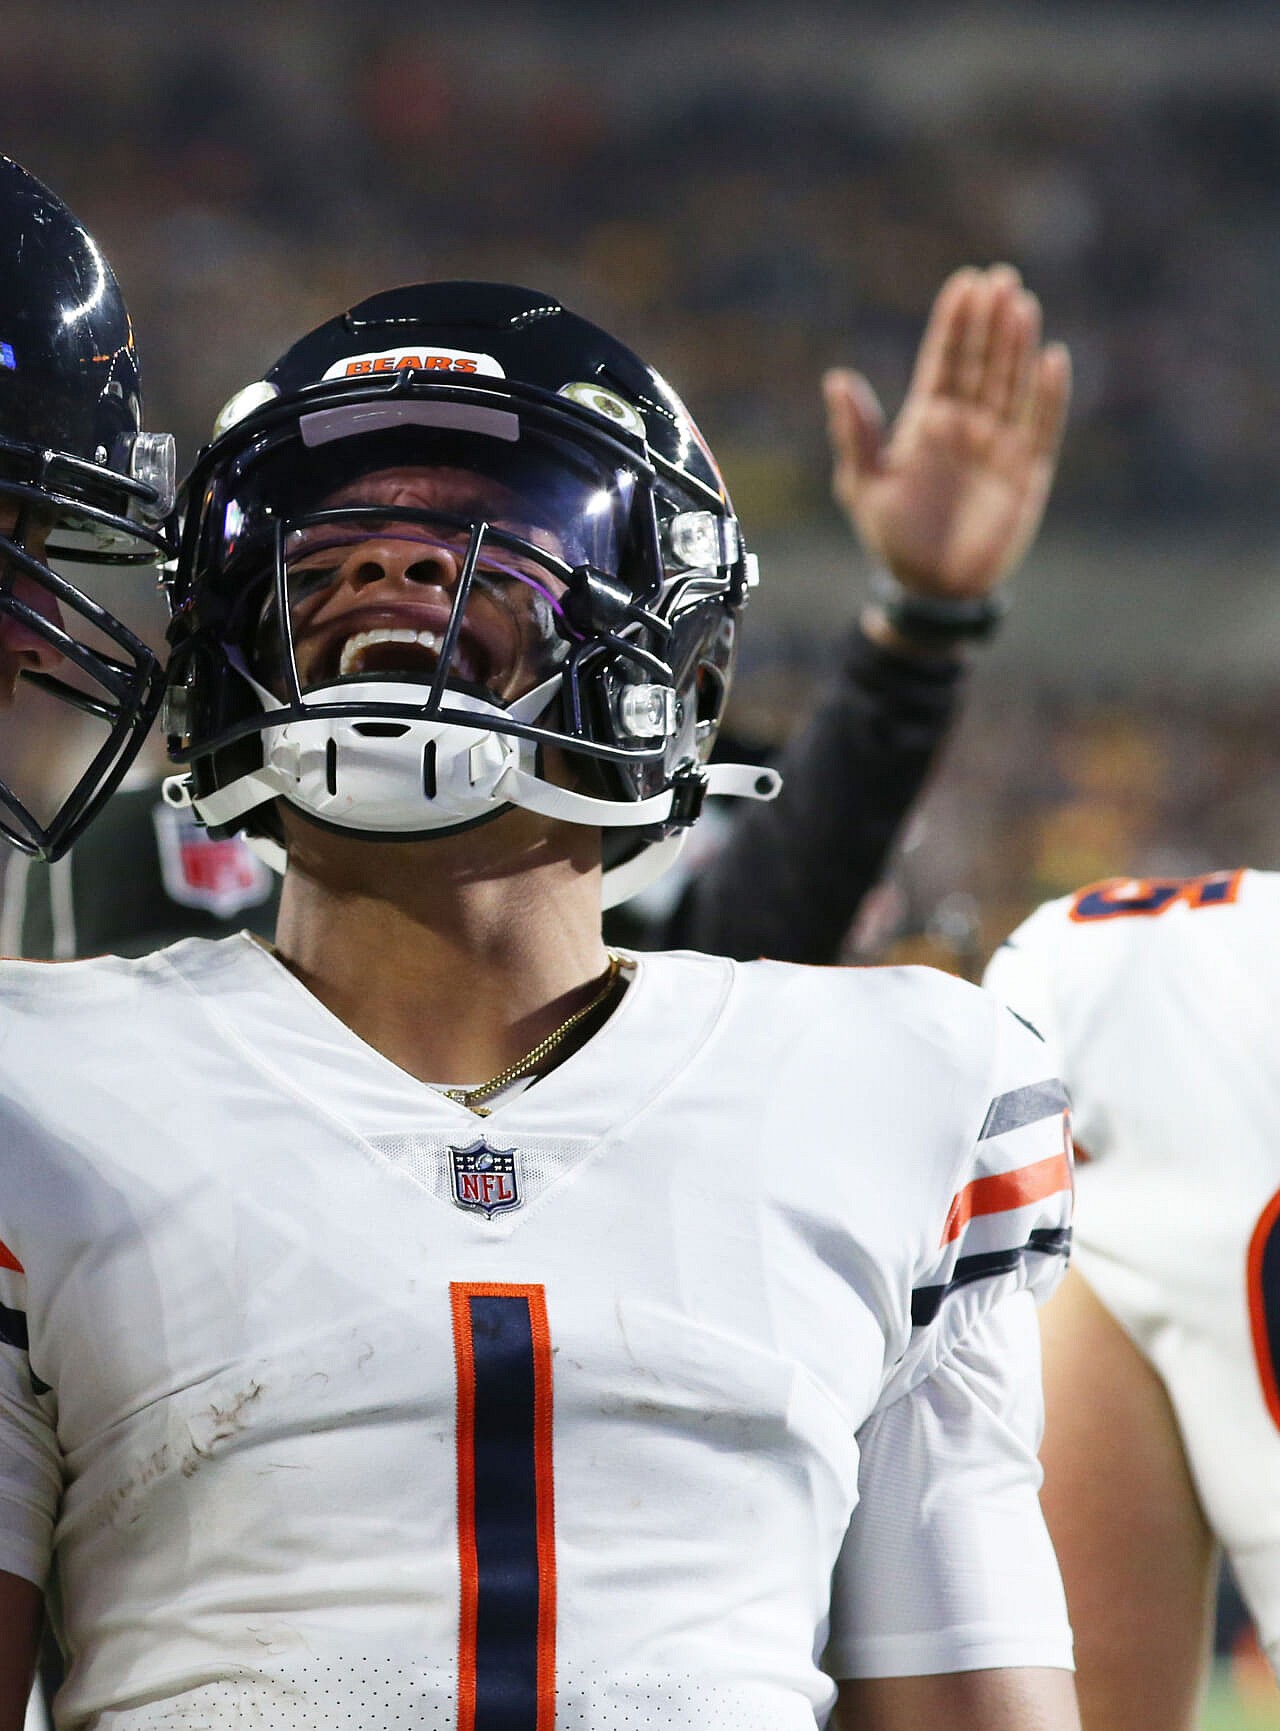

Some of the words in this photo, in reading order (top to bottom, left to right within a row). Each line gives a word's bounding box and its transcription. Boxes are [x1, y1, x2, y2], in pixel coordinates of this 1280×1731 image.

[345, 355, 478, 376] BEARS
[461, 1174, 512, 1203] NFL
[449, 1281, 557, 1731] 1
